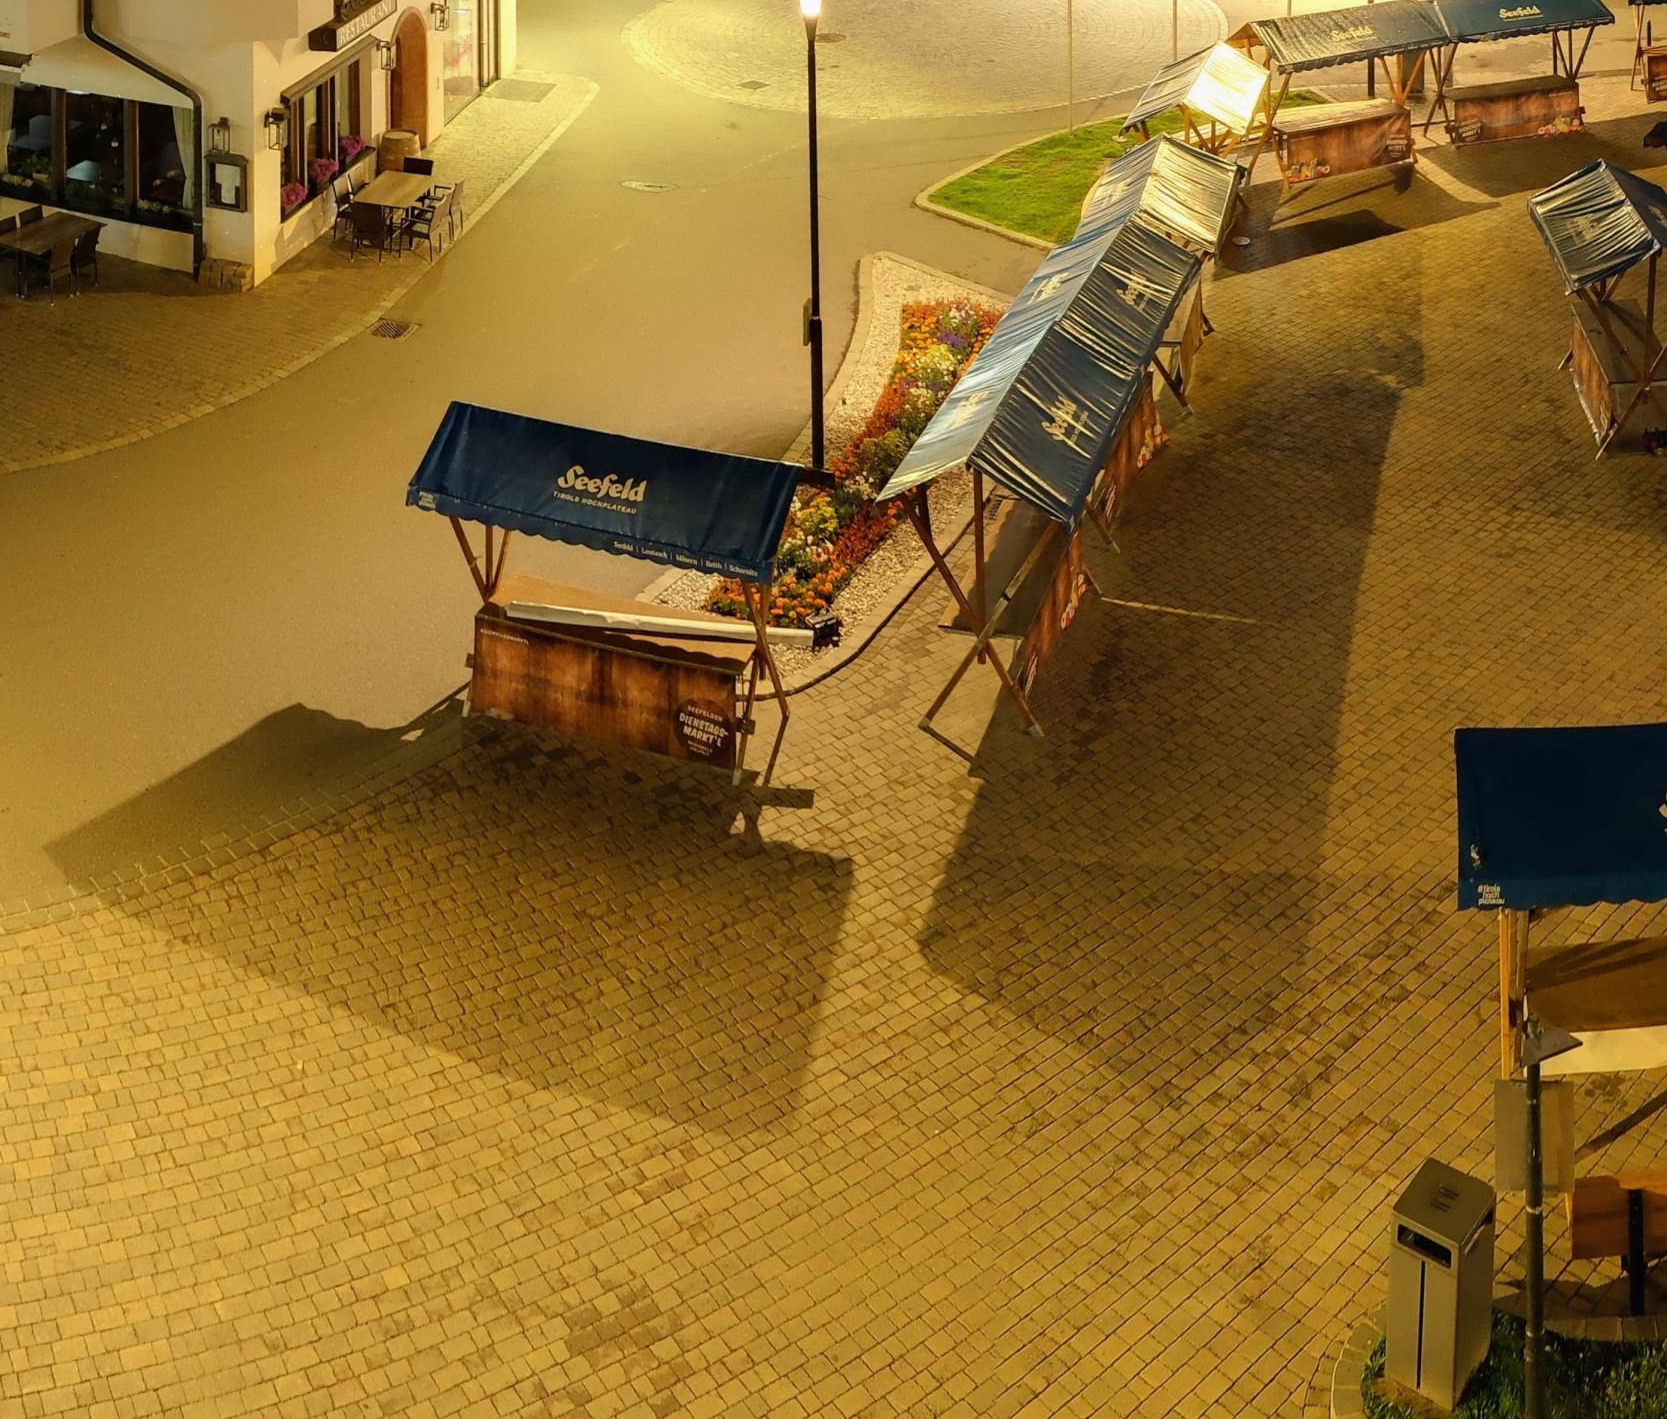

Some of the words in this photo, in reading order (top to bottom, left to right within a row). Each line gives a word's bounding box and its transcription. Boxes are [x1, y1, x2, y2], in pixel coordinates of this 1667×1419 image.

[1498, 4, 1542, 20] Seefeld
[557, 464, 648, 503] Seefeld
[552, 490, 580, 505] TIROLS
[581, 495, 637, 515] HOCHPLATEAU
[678, 712, 729, 737] DIENSTAGS-
